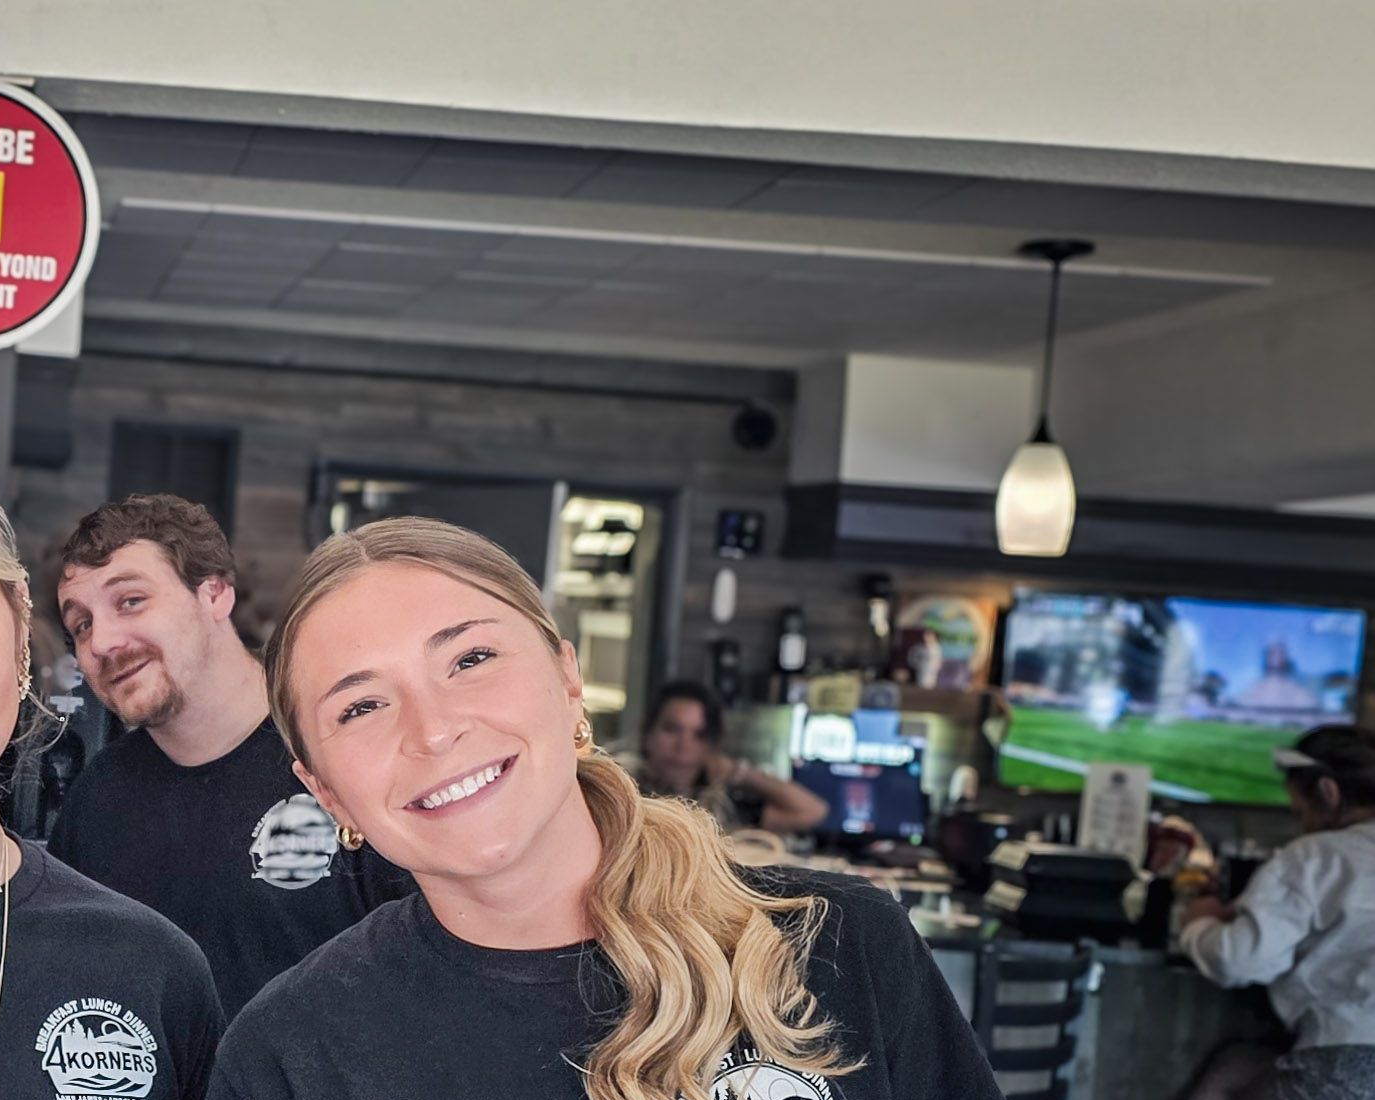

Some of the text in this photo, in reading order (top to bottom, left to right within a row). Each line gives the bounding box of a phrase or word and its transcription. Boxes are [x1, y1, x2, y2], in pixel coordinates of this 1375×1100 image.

[35, 998, 158, 1053] BREAKFAST LUNCH DINNER
